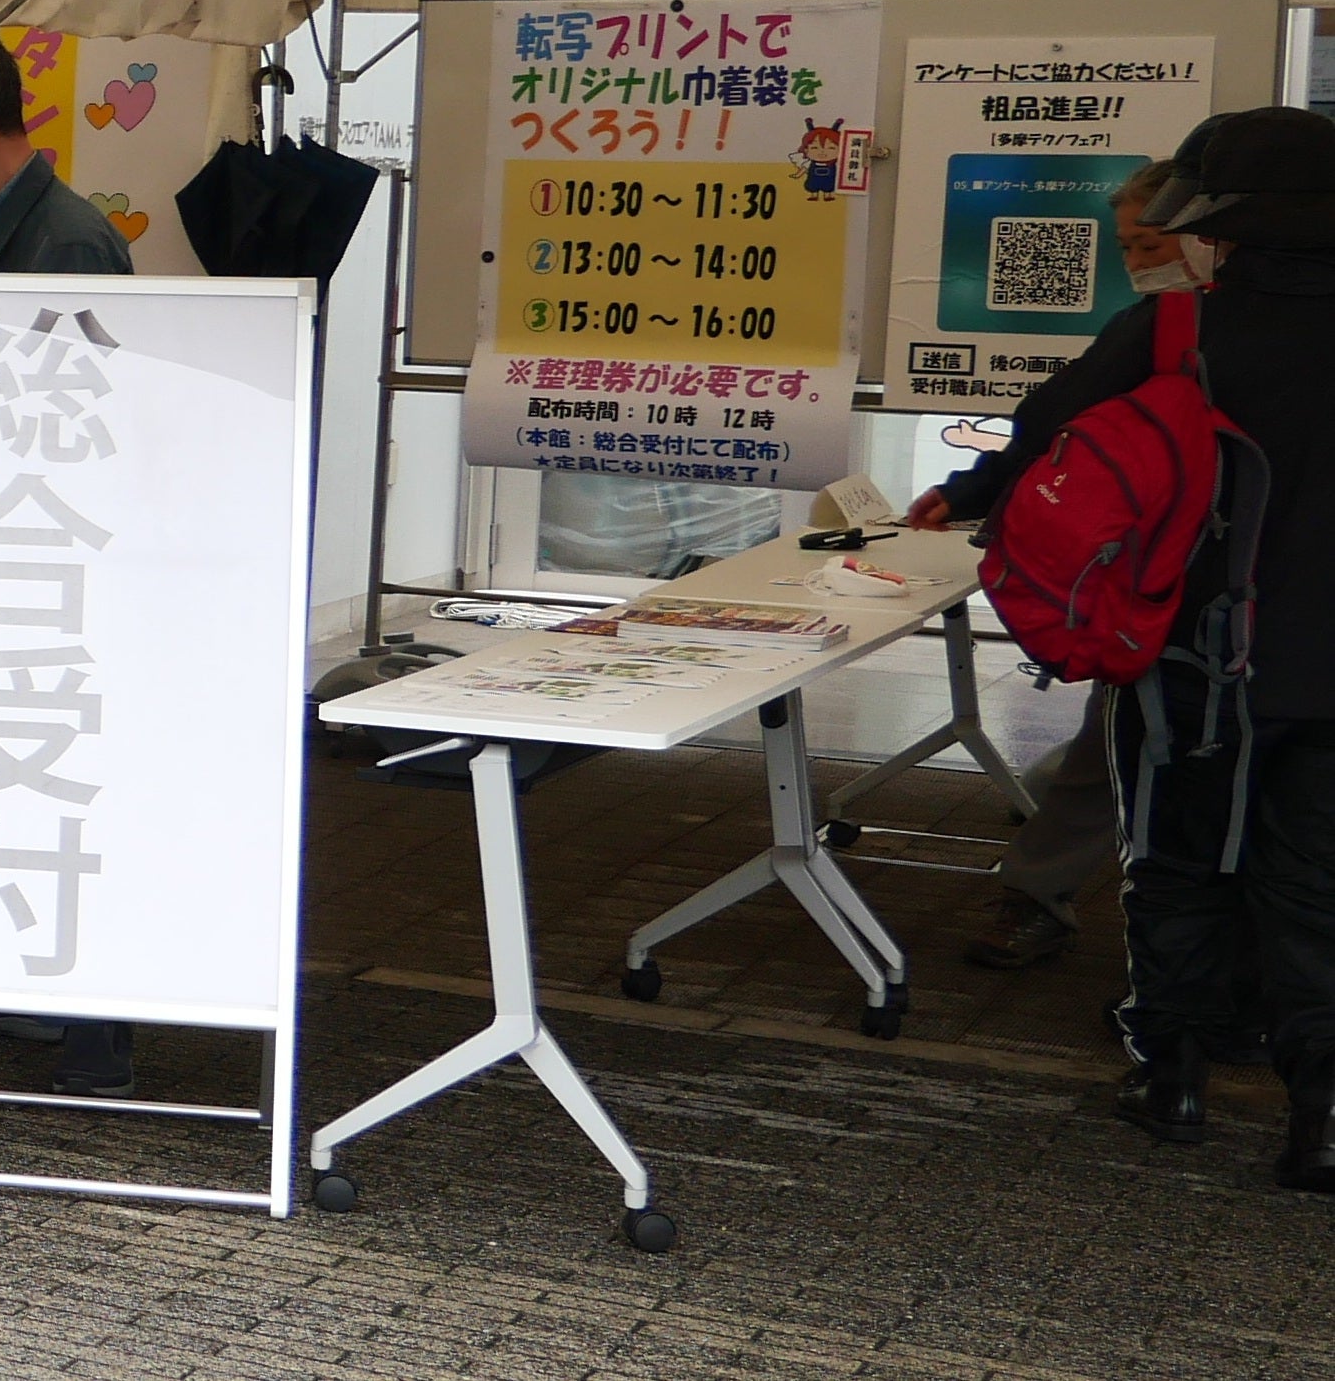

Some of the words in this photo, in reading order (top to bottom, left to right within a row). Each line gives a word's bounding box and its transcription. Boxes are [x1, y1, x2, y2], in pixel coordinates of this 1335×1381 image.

[515, 11, 793, 61] 転写プリントで
[511, 65, 823, 107] オリジナル巾着袋を
[915, 62, 1194, 81] アンケートにご協力ください！
[504, 357, 821, 403] ※整理券が必要です。
[922, 351, 962, 370] 送信
[989, 354, 1076, 374] 後の画面
